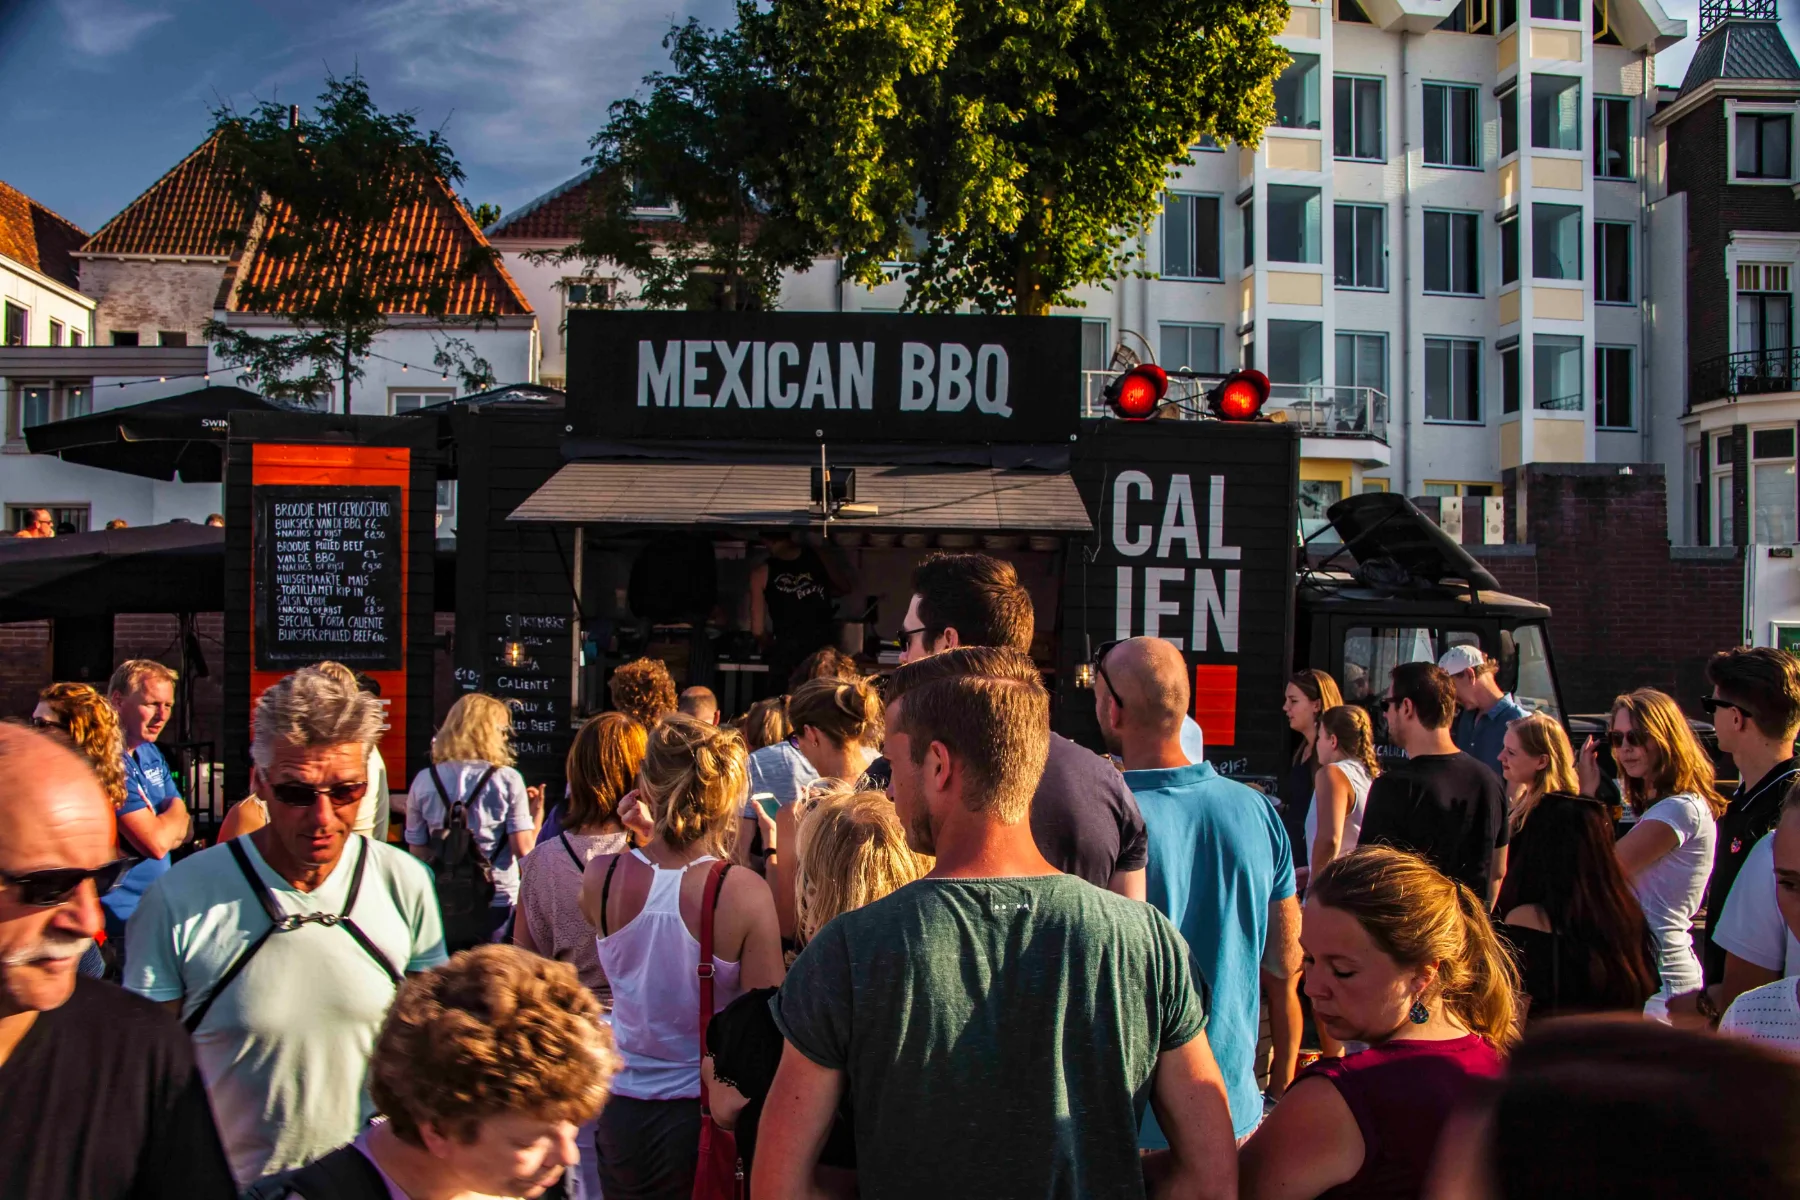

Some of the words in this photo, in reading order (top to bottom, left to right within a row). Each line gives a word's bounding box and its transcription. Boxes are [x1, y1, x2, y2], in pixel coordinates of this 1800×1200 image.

[637, 340, 875, 410] MEXICAN
[900, 342, 1012, 418] BBQ
[318, 503, 338, 517] MET
[1112, 470, 1241, 560] CAL
[275, 518, 314, 529] BUIKSPEK
[316, 519, 332, 529] VAN
[333, 518, 342, 529] DE
[344, 518, 362, 529] BBQ
[343, 541, 364, 551] BEEF
[277, 554, 296, 563] VAN
[297, 554, 309, 563] DE
[315, 553, 336, 563] BBQ
[276, 574, 341, 586] HUISGEMAAKTE
[318, 585, 333, 596] MET
[336, 587, 351, 597] KIP
[276, 595, 301, 606] SALSA
[1116, 566, 1241, 653] IEN
[278, 615, 315, 628] SPECIAL
[320, 615, 345, 627] TORTA
[347, 616, 384, 629] CALIENTE
[278, 629, 318, 641] BUIKSPEK
[353, 630, 371, 642] BEEF
[531, 719, 556, 732] BEEF
